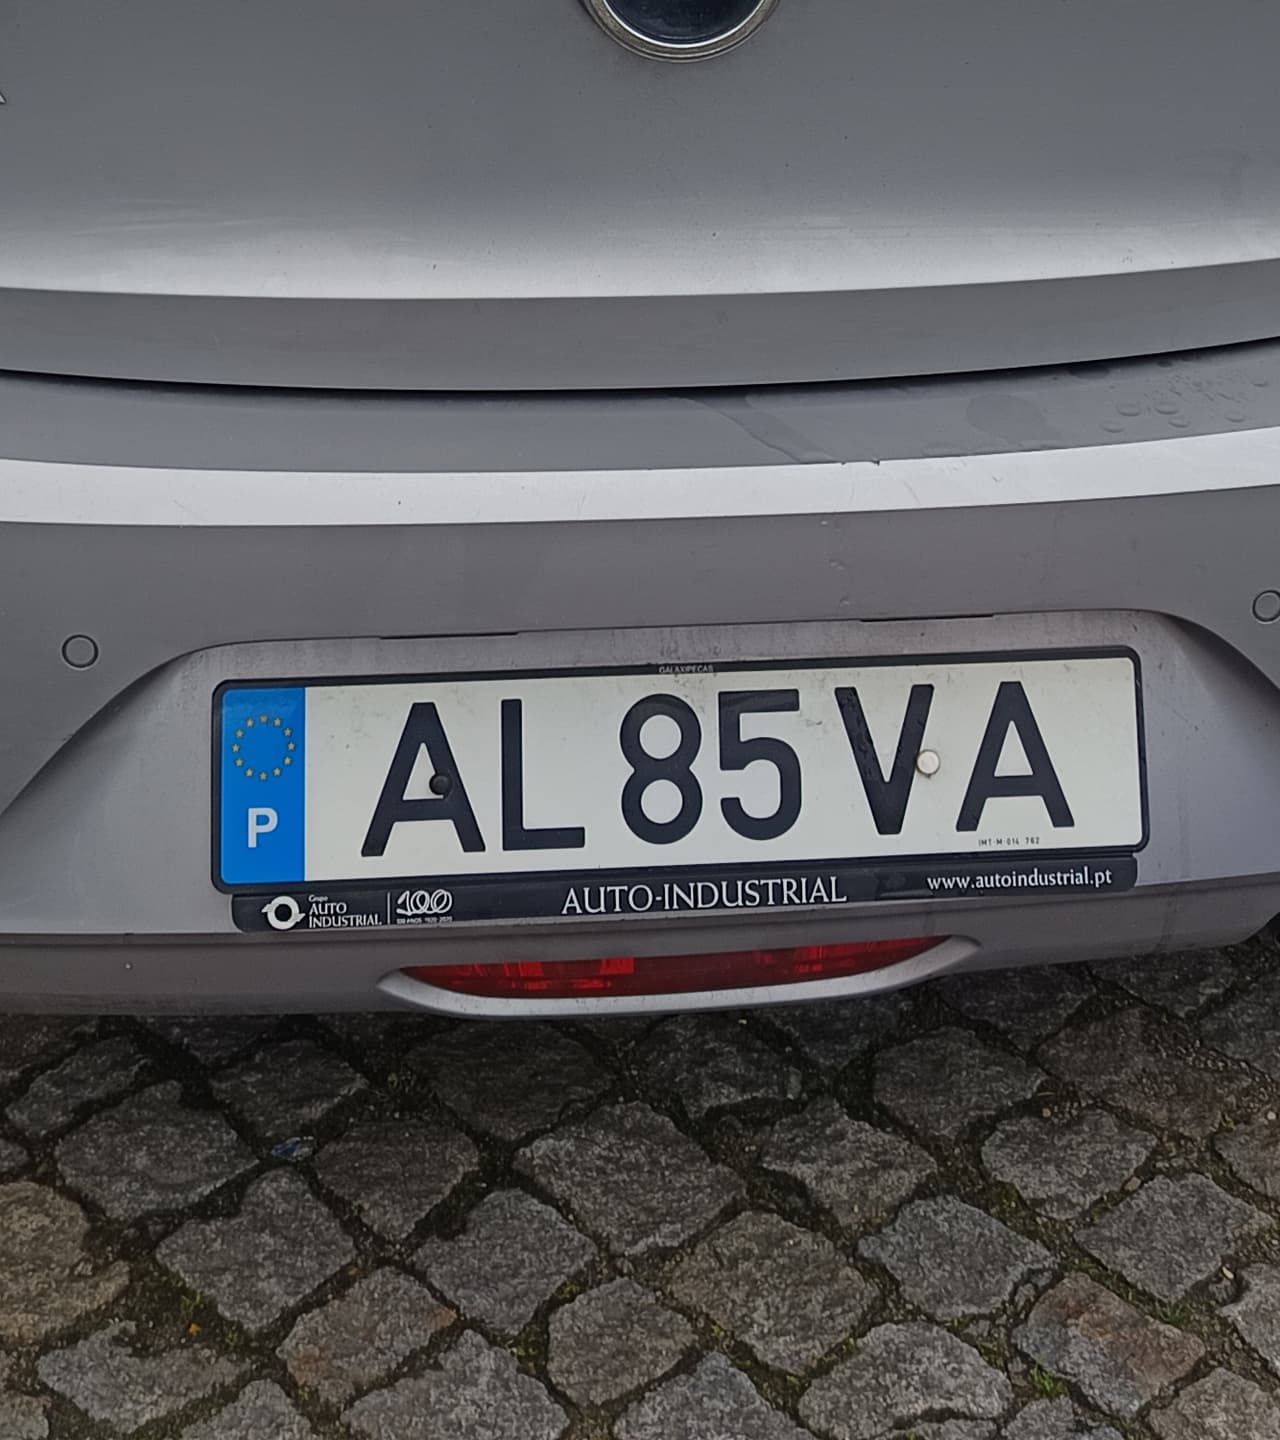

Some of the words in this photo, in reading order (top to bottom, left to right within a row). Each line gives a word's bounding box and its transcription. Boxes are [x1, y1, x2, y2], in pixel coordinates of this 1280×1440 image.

[247, 807, 278, 848] P
[927, 866, 1113, 890] www.autoindustrial.pt
[396, 888, 453, 917] 100
[560, 876, 848, 915] AUTO-INDUSTRIAL
[308, 902, 348, 916] AUTO
[308, 913, 383, 929] INDUSTRIAL
